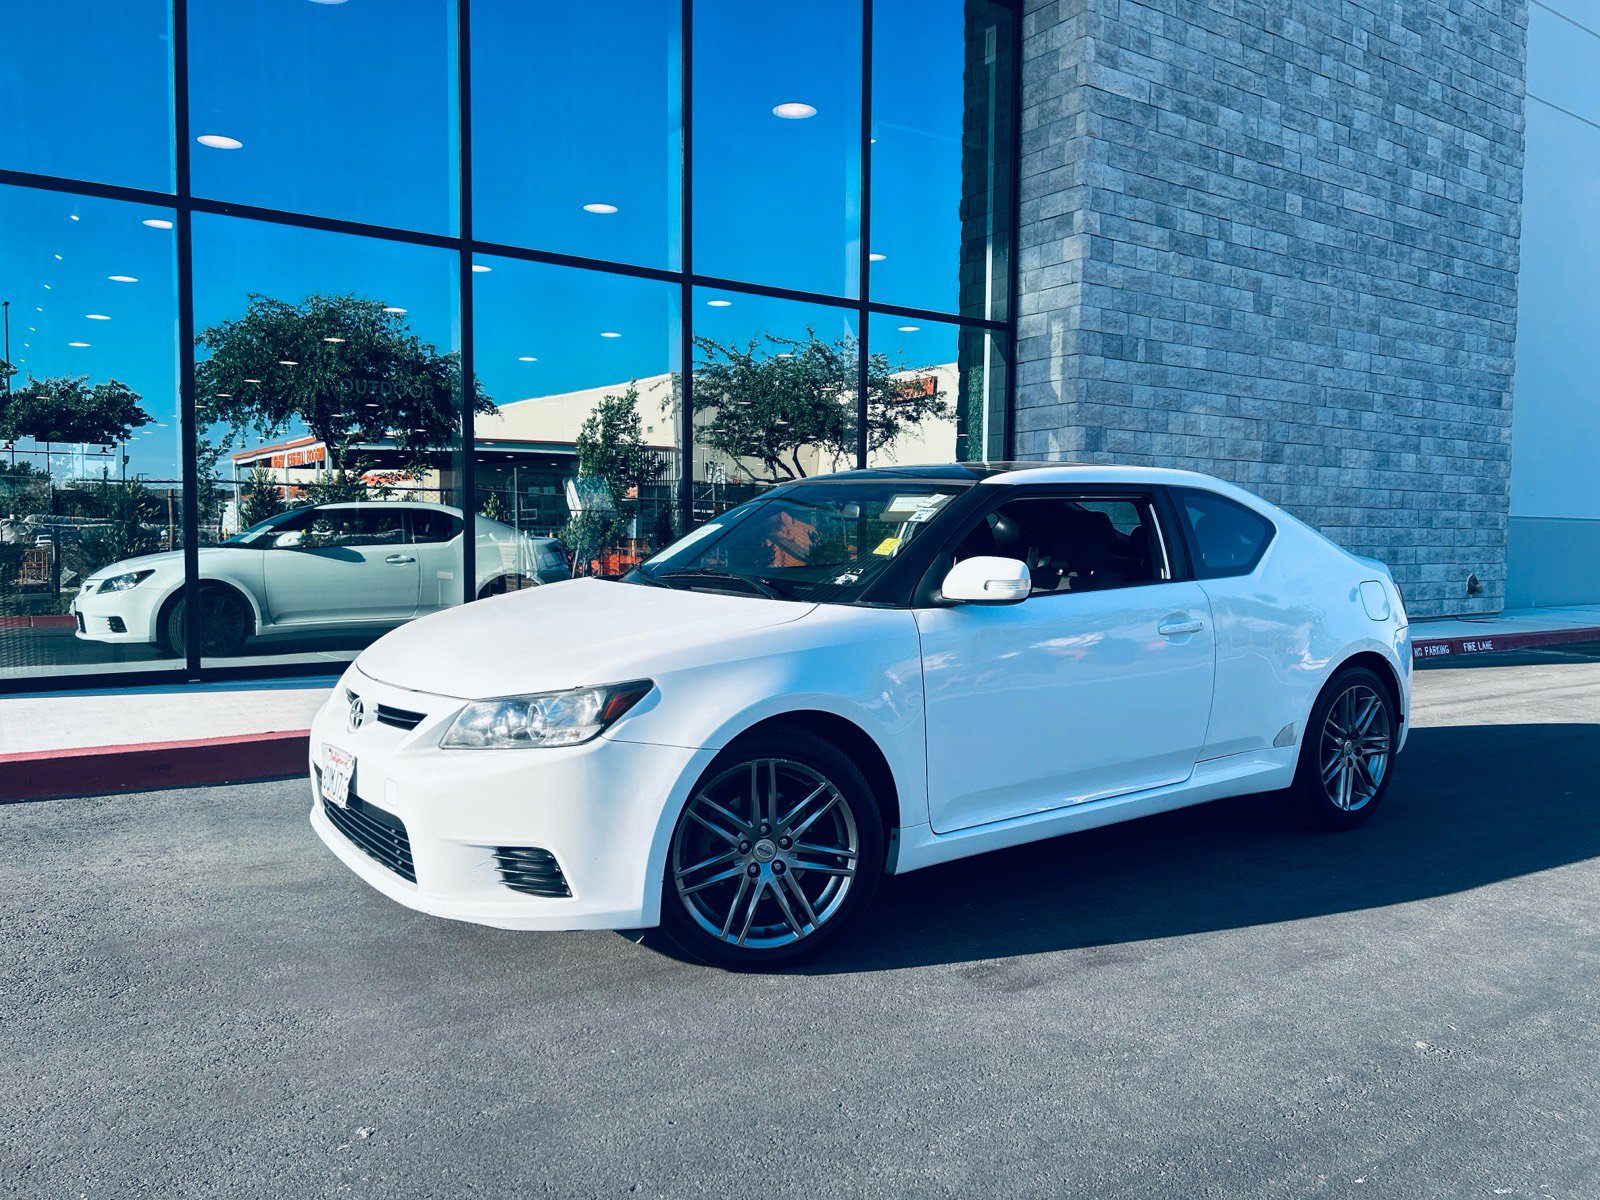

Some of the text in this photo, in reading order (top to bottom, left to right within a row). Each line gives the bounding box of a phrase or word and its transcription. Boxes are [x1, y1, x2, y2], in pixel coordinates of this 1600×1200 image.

[340, 378, 434, 399] OUTDOOR
[1414, 641, 1494, 657] NO PARKING FIRE LANE
